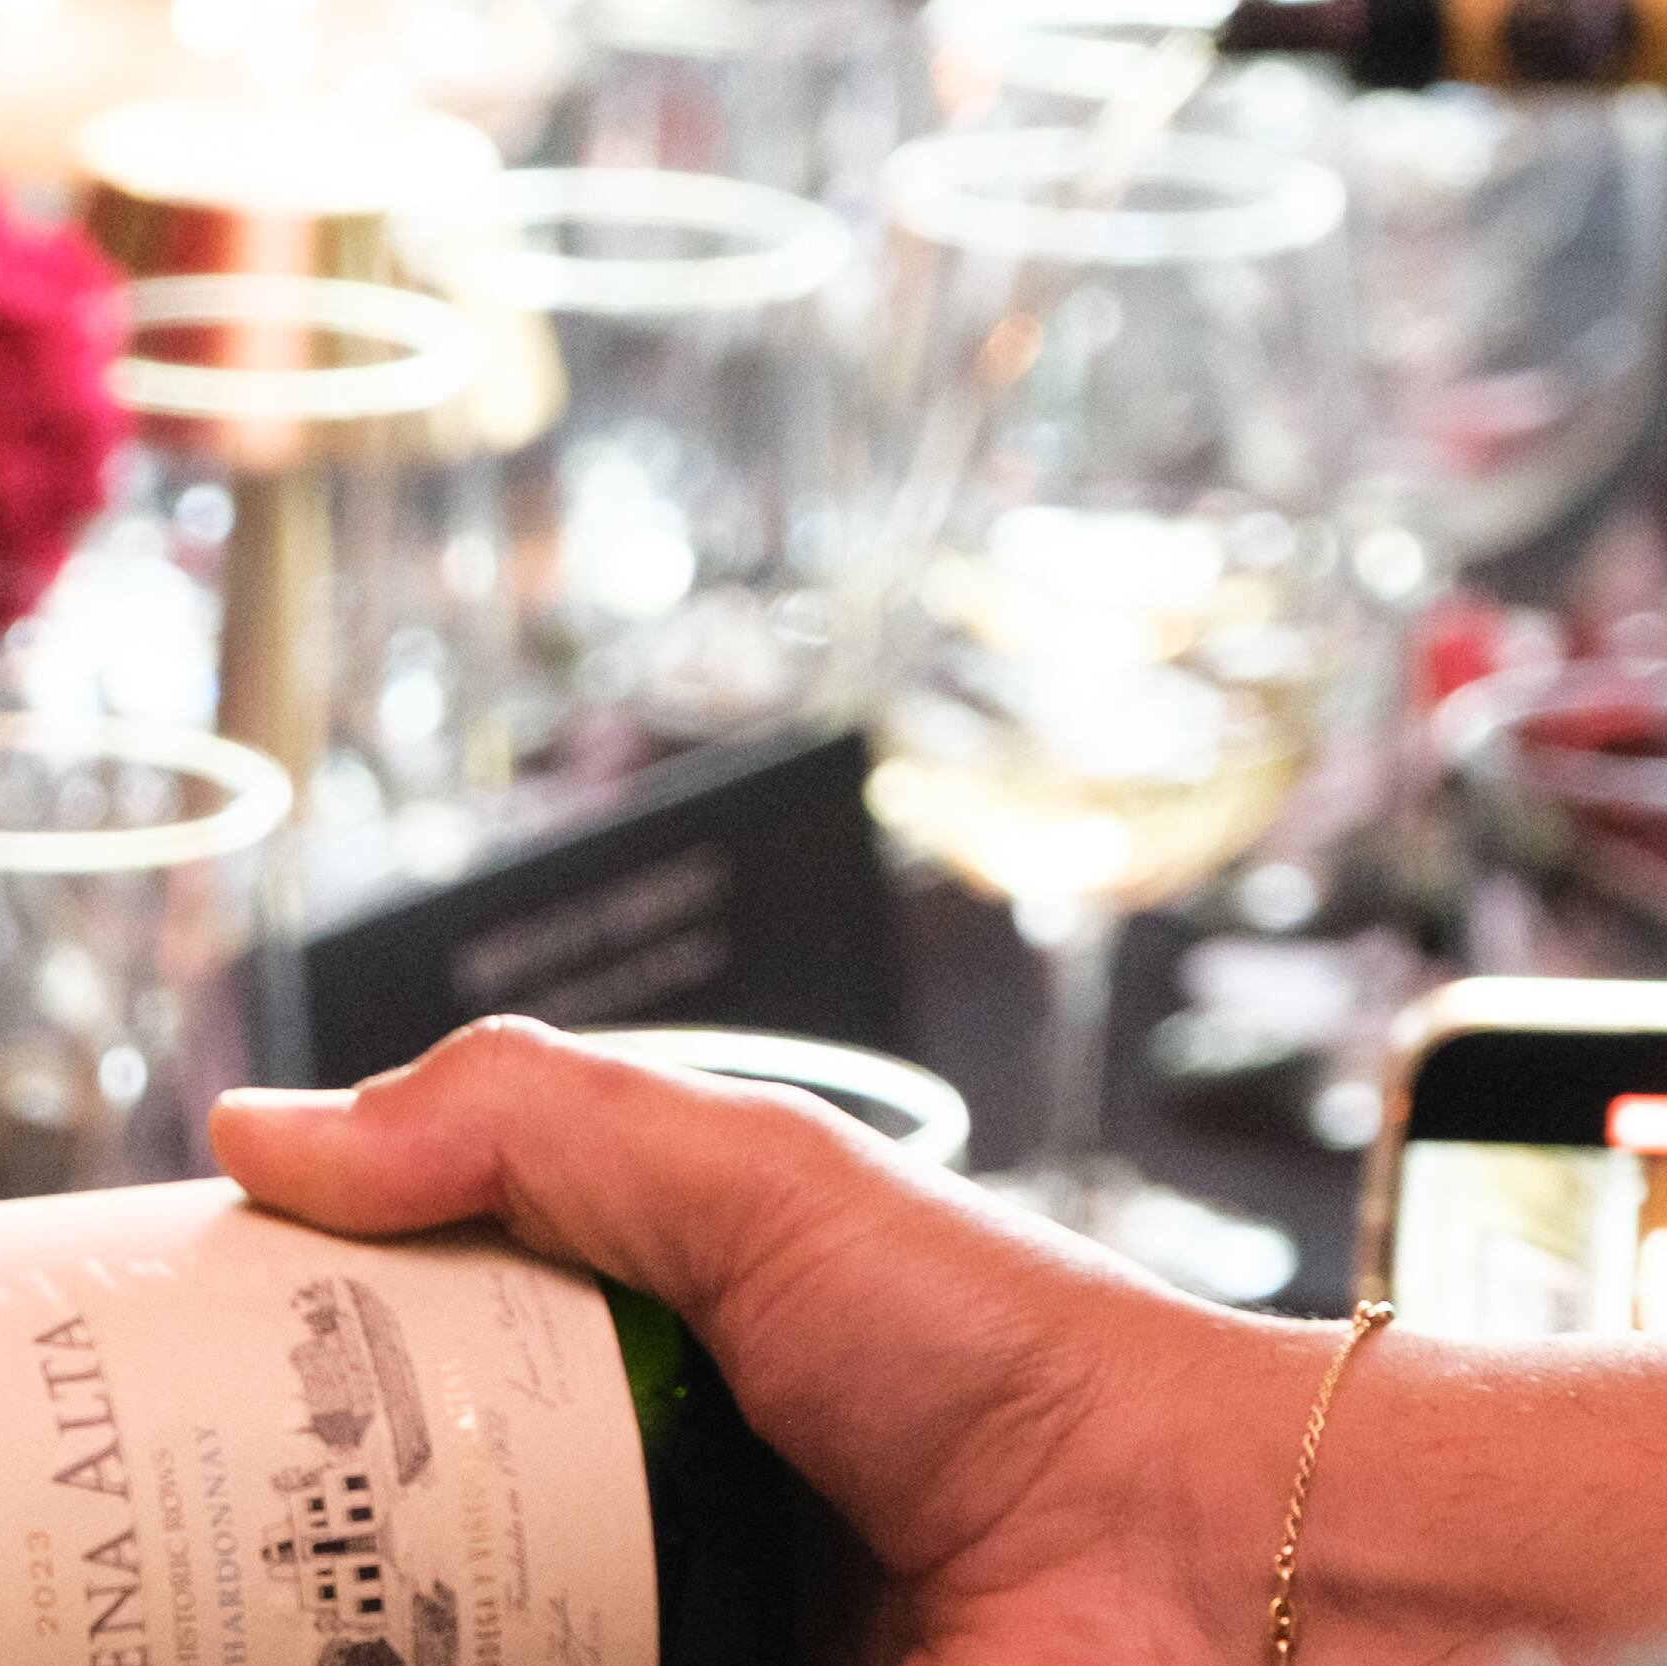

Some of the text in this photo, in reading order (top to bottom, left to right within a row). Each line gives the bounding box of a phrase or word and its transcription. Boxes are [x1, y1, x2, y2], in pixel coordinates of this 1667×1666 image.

[34, 1312, 131, 1500] ALTA
[154, 1446, 186, 1534] ROWS
[25, 1527, 61, 1639] 2023
